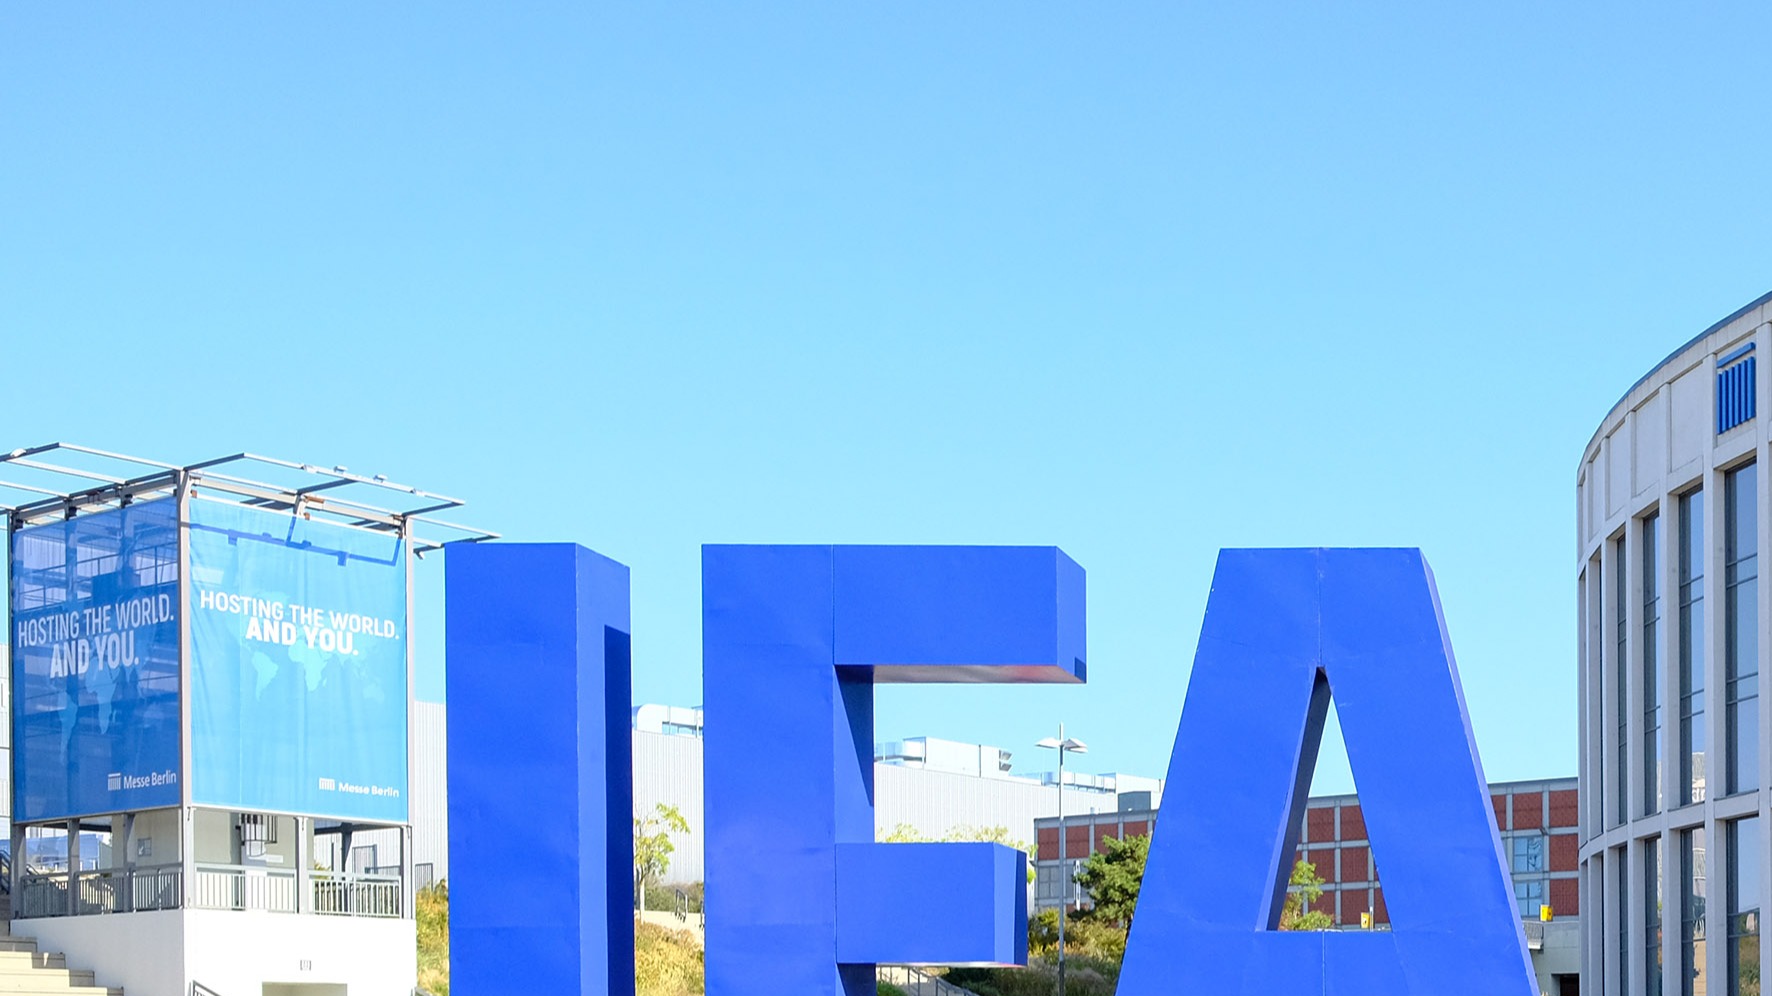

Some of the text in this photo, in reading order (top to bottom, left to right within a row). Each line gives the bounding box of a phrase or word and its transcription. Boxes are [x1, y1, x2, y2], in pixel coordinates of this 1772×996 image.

[18, 593, 175, 648] HOSTING THE WORLD.
[200, 589, 400, 640] HOSTING THE WORLD.
[245, 616, 359, 656] AND YOU.
[50, 630, 140, 679] AND YOU.
[123, 770, 177, 790] Messe Berlin
[338, 782, 400, 798] Messe Berlin
